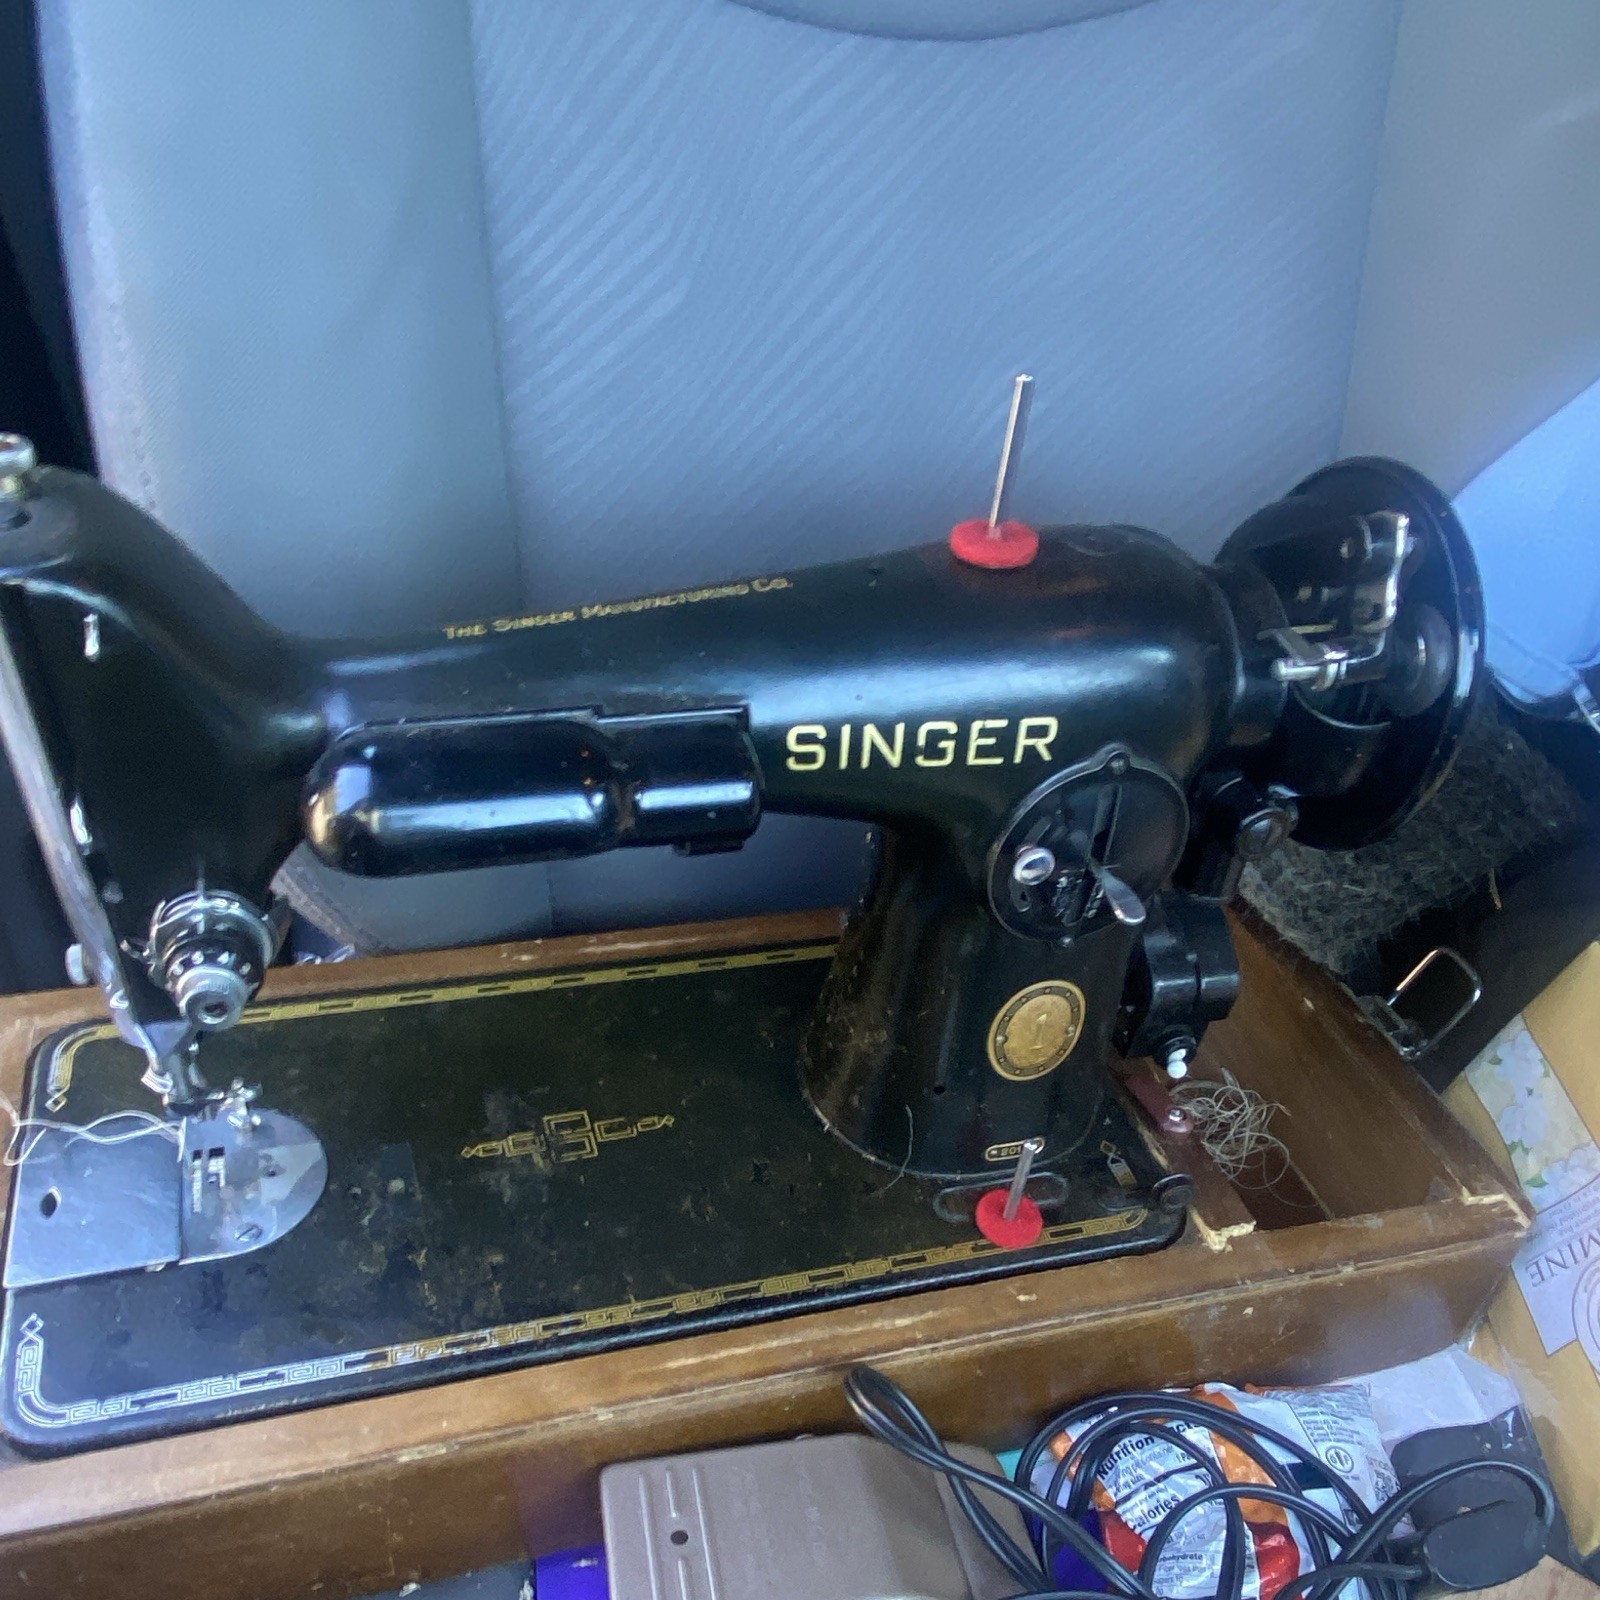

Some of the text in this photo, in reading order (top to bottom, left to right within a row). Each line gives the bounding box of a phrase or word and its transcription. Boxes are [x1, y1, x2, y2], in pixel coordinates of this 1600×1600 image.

[786, 716, 1059, 771] SINGER
[1097, 1434, 1155, 1480] Nutrition
[1159, 1552, 1203, 1563] rbohydrate
